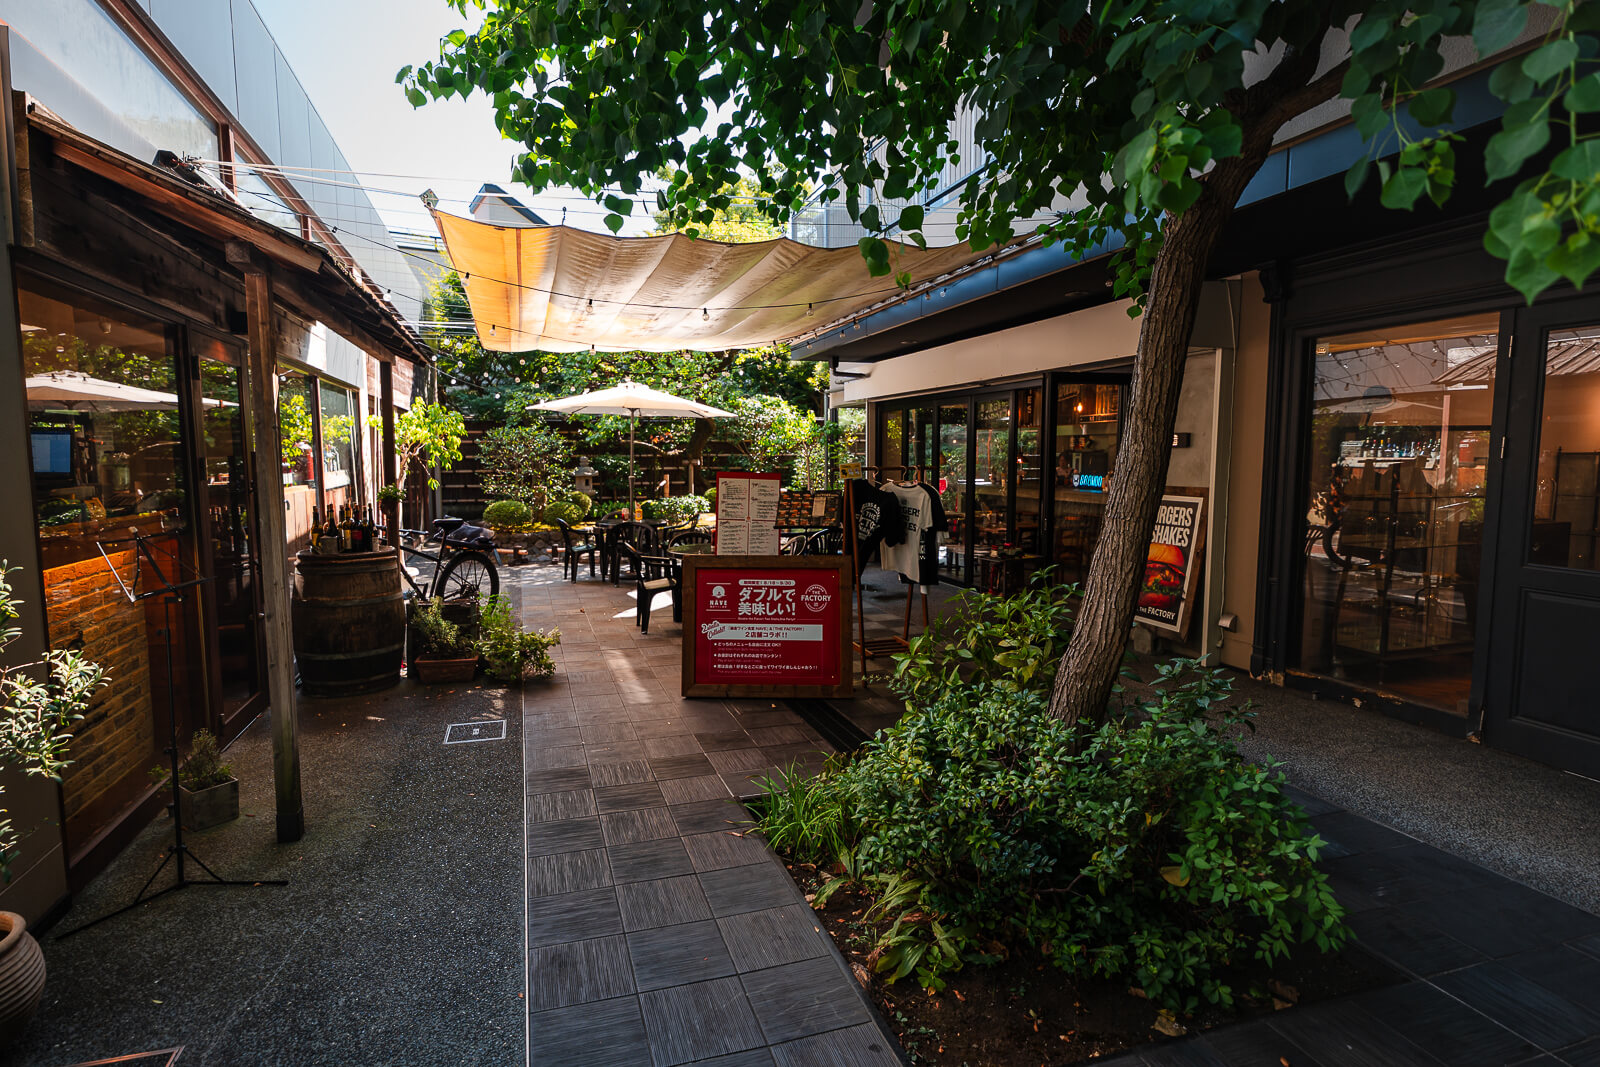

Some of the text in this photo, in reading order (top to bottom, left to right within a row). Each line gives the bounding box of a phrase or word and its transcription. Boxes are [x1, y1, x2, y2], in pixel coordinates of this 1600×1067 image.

[739, 587, 796, 602] ダブルで
[800, 594, 832, 602] FACTORY
[1147, 606, 1176, 620] FACTORY
